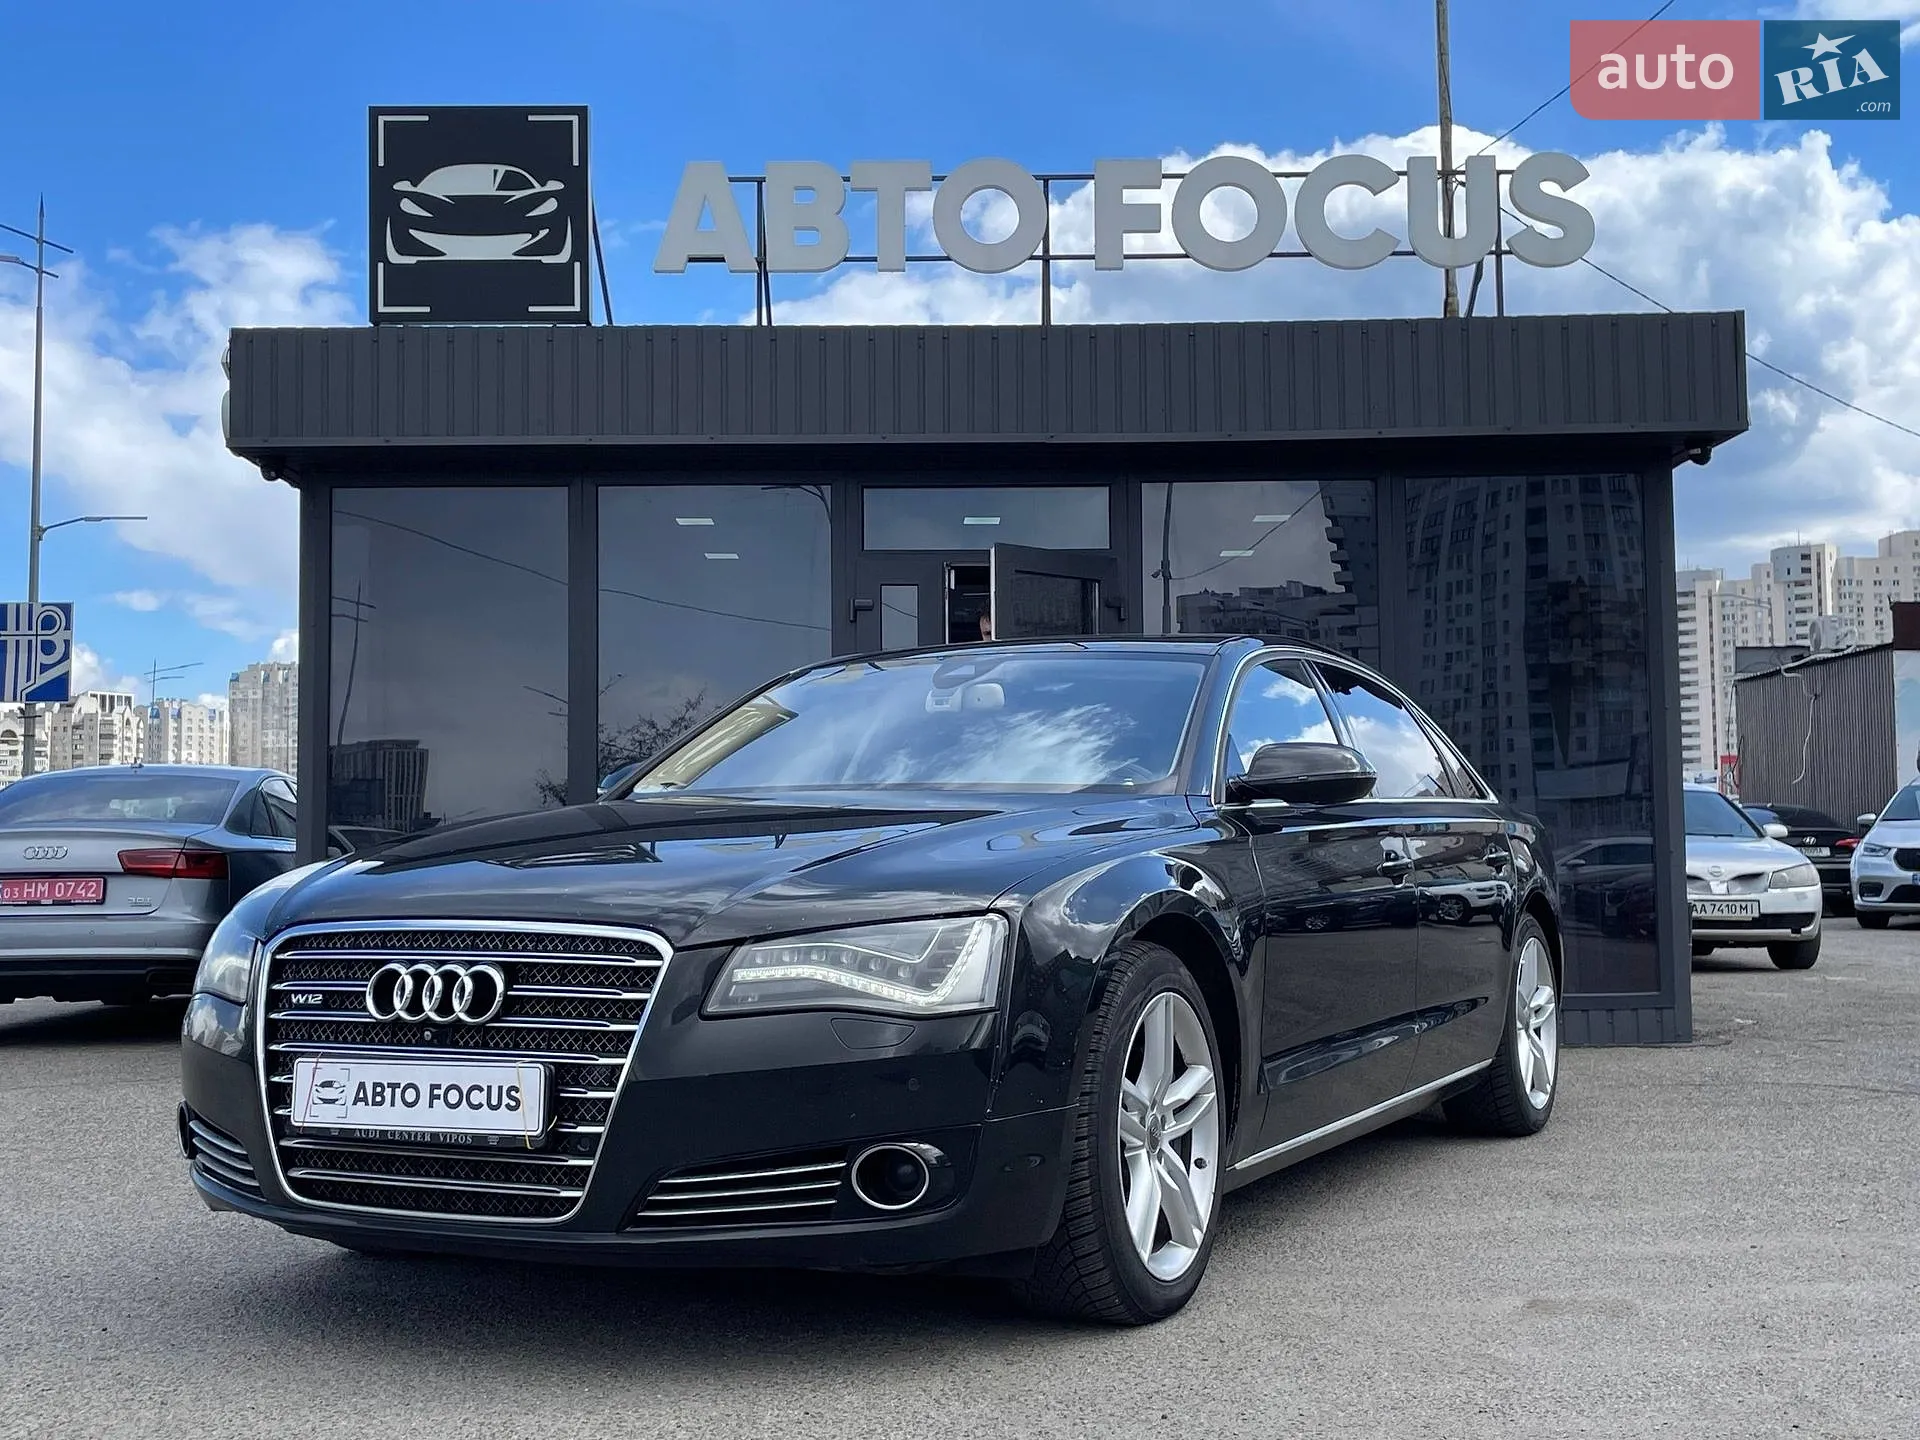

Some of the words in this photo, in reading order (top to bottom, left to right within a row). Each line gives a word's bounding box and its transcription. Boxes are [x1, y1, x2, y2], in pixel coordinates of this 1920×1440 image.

[654, 157, 1048, 275] АВТО
[1094, 152, 1596, 272] FOCUS
[3, 887, 20, 899] 03
[23, 882, 49, 899] HM
[55, 881, 97, 898] 0742
[1691, 903, 1708, 915] AA
[1710, 903, 1737, 915] 7410
[1740, 903, 1754, 915] MI
[291, 993, 323, 1004] W12
[352, 1081, 421, 1109] АВТО
[428, 1083, 522, 1112] FOCUS
[354, 1129, 380, 1139] AUDI
[387, 1130, 431, 1142] CENTER
[439, 1133, 473, 1145] VIPOS
